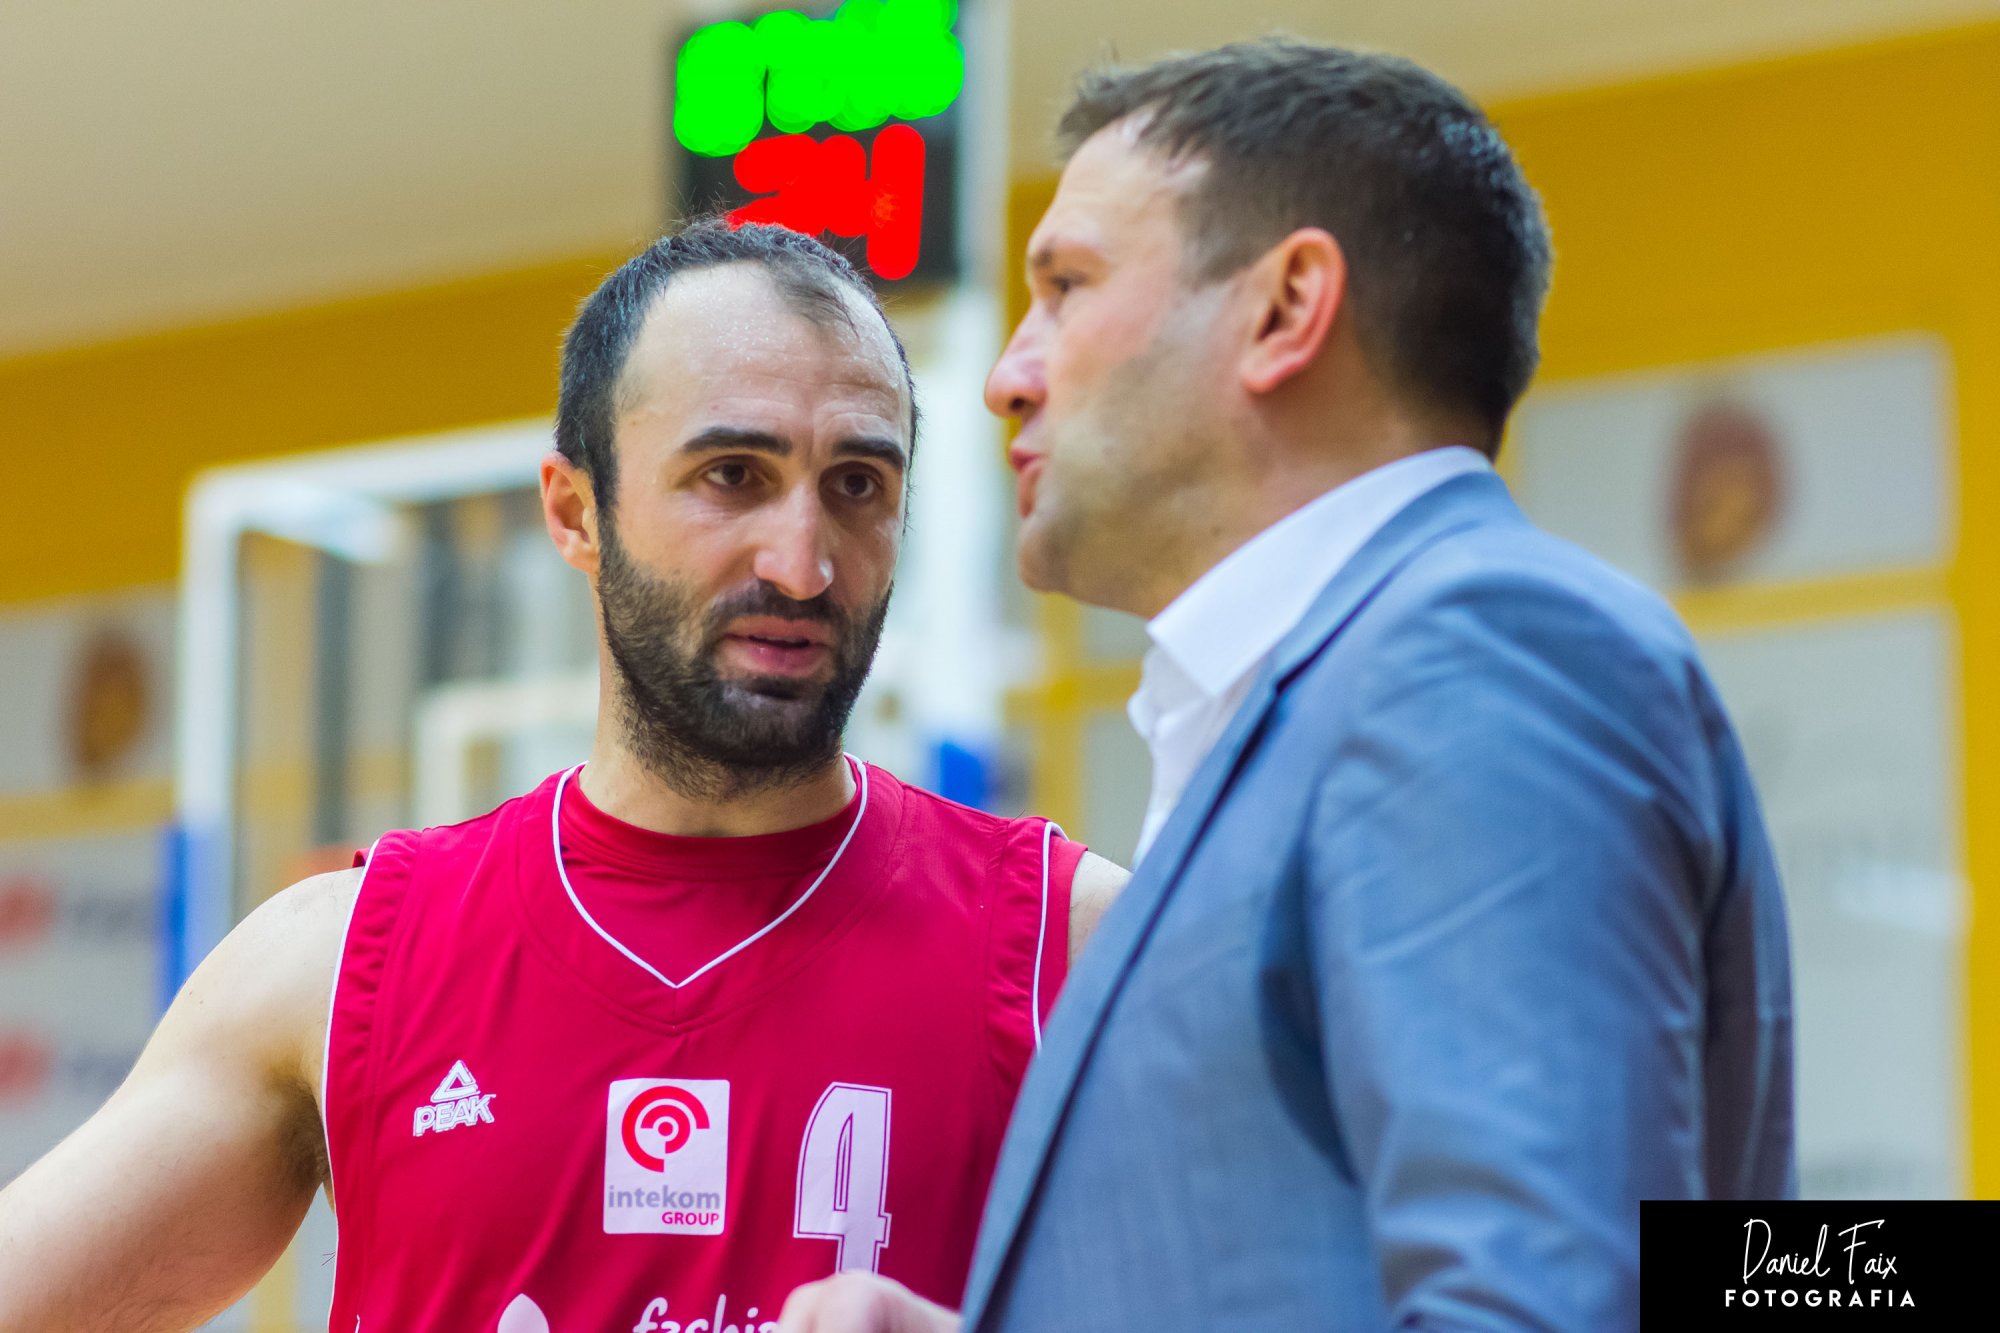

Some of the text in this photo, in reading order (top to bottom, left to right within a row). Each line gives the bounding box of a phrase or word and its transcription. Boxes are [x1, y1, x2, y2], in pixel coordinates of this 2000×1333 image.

[412, 1093, 497, 1137] PEAK
[793, 1081, 892, 1276] 4
[607, 1185, 721, 1210] intekom
[661, 1211, 720, 1226] GROUP
